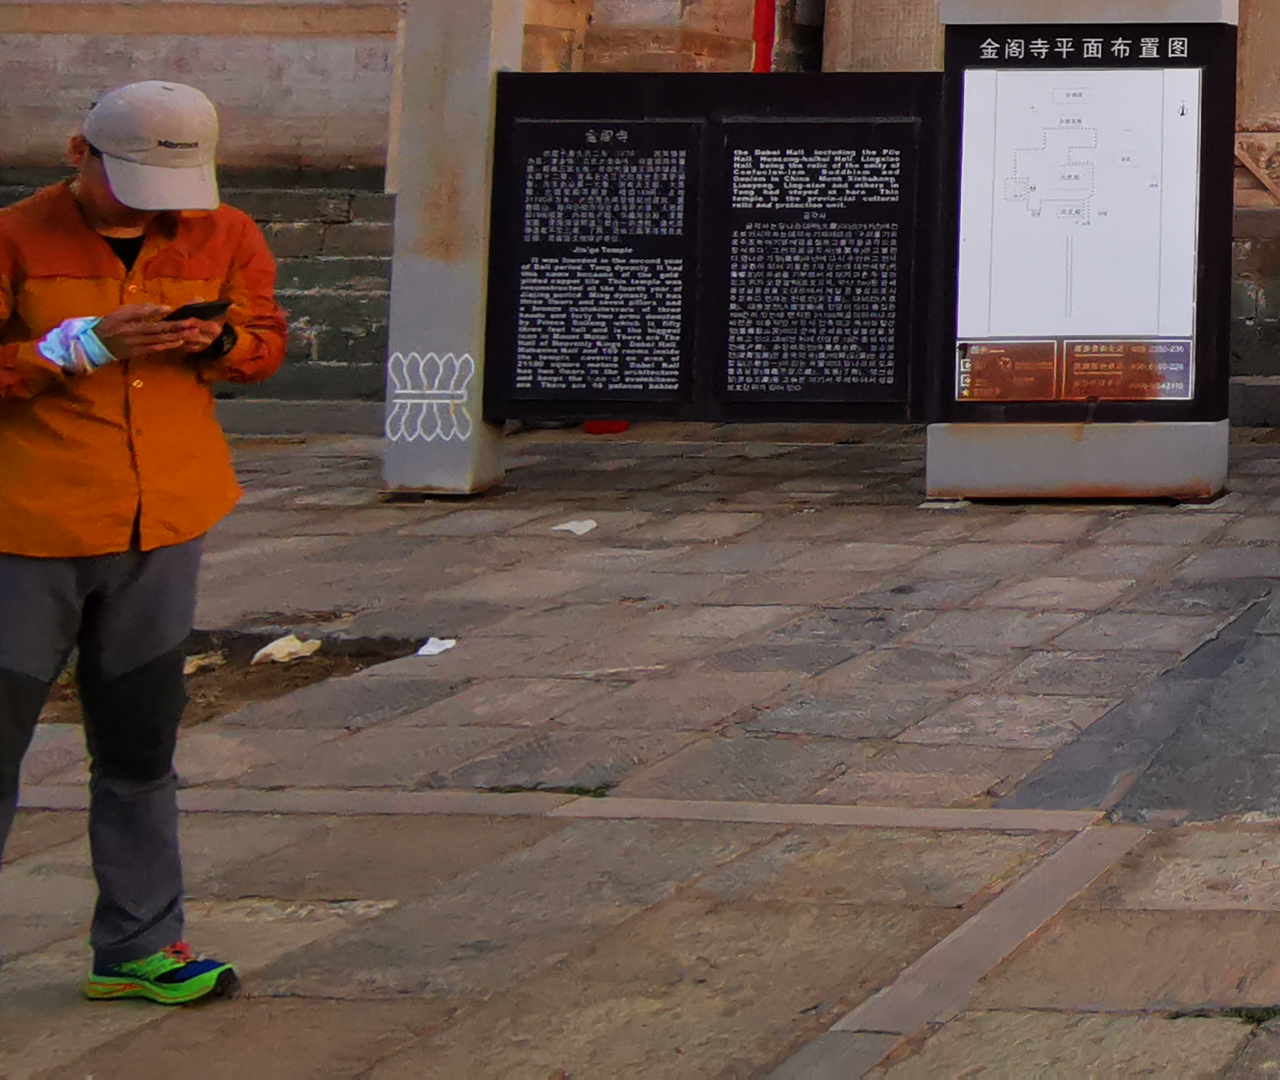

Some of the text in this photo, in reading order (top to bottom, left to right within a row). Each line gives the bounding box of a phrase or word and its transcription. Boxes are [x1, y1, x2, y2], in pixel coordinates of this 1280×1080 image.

[979, 37, 1189, 60] 金阁寺平面布置图
